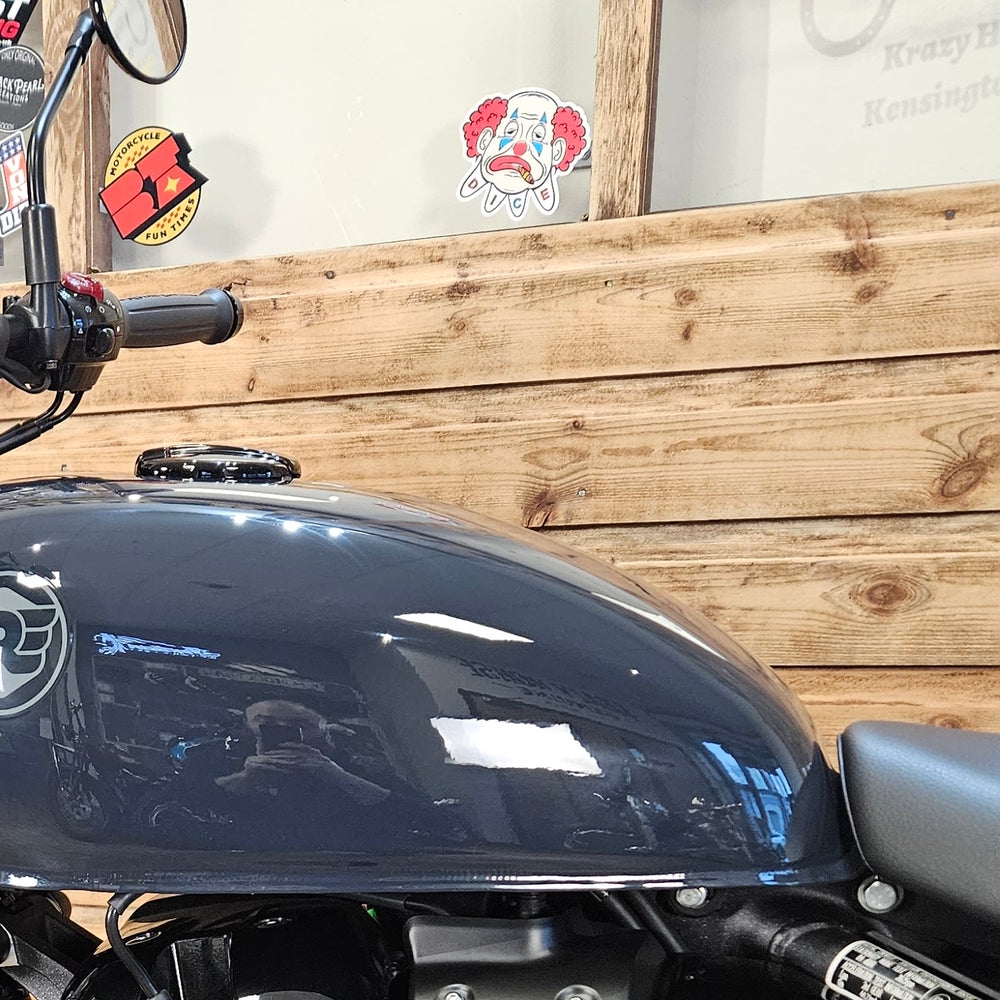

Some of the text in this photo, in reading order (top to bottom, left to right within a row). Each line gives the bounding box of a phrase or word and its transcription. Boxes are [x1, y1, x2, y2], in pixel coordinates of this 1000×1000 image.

[881, 32, 971, 71] Krazy
[109, 132, 161, 176] MOTORCYCLE
[146, 198, 195, 240] FUN TIMES
